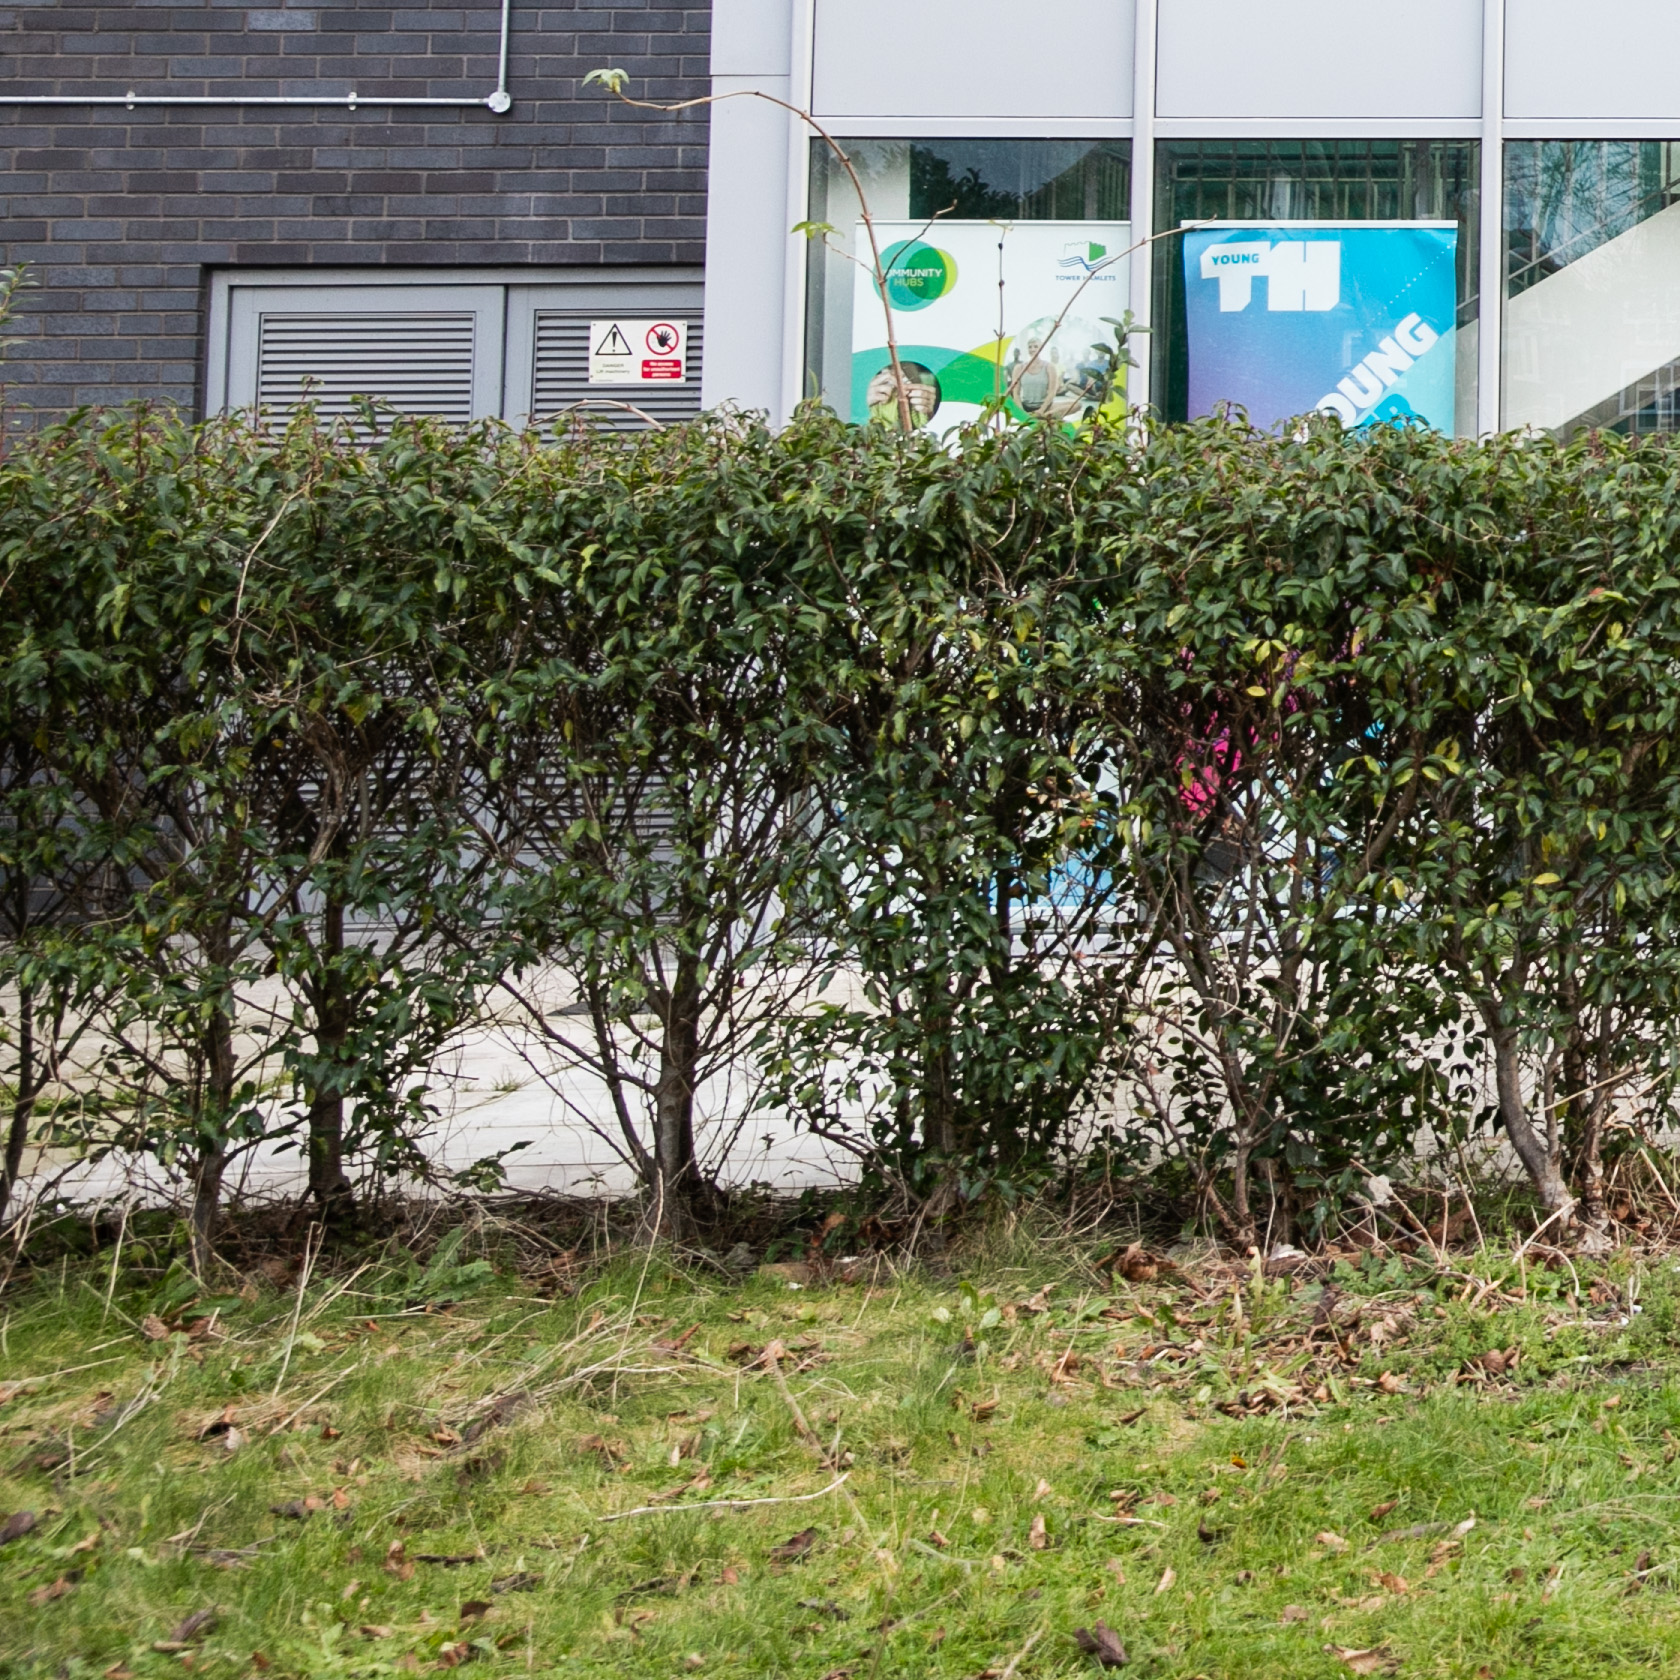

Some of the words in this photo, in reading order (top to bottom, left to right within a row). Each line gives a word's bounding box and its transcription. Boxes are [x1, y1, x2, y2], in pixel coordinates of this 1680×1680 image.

[1211, 253, 1260, 266] YOUNG
[882, 268, 943, 277] OMMUNITY
[894, 277, 924, 287] HUBS
[1314, 312, 1440, 430] OUNG
